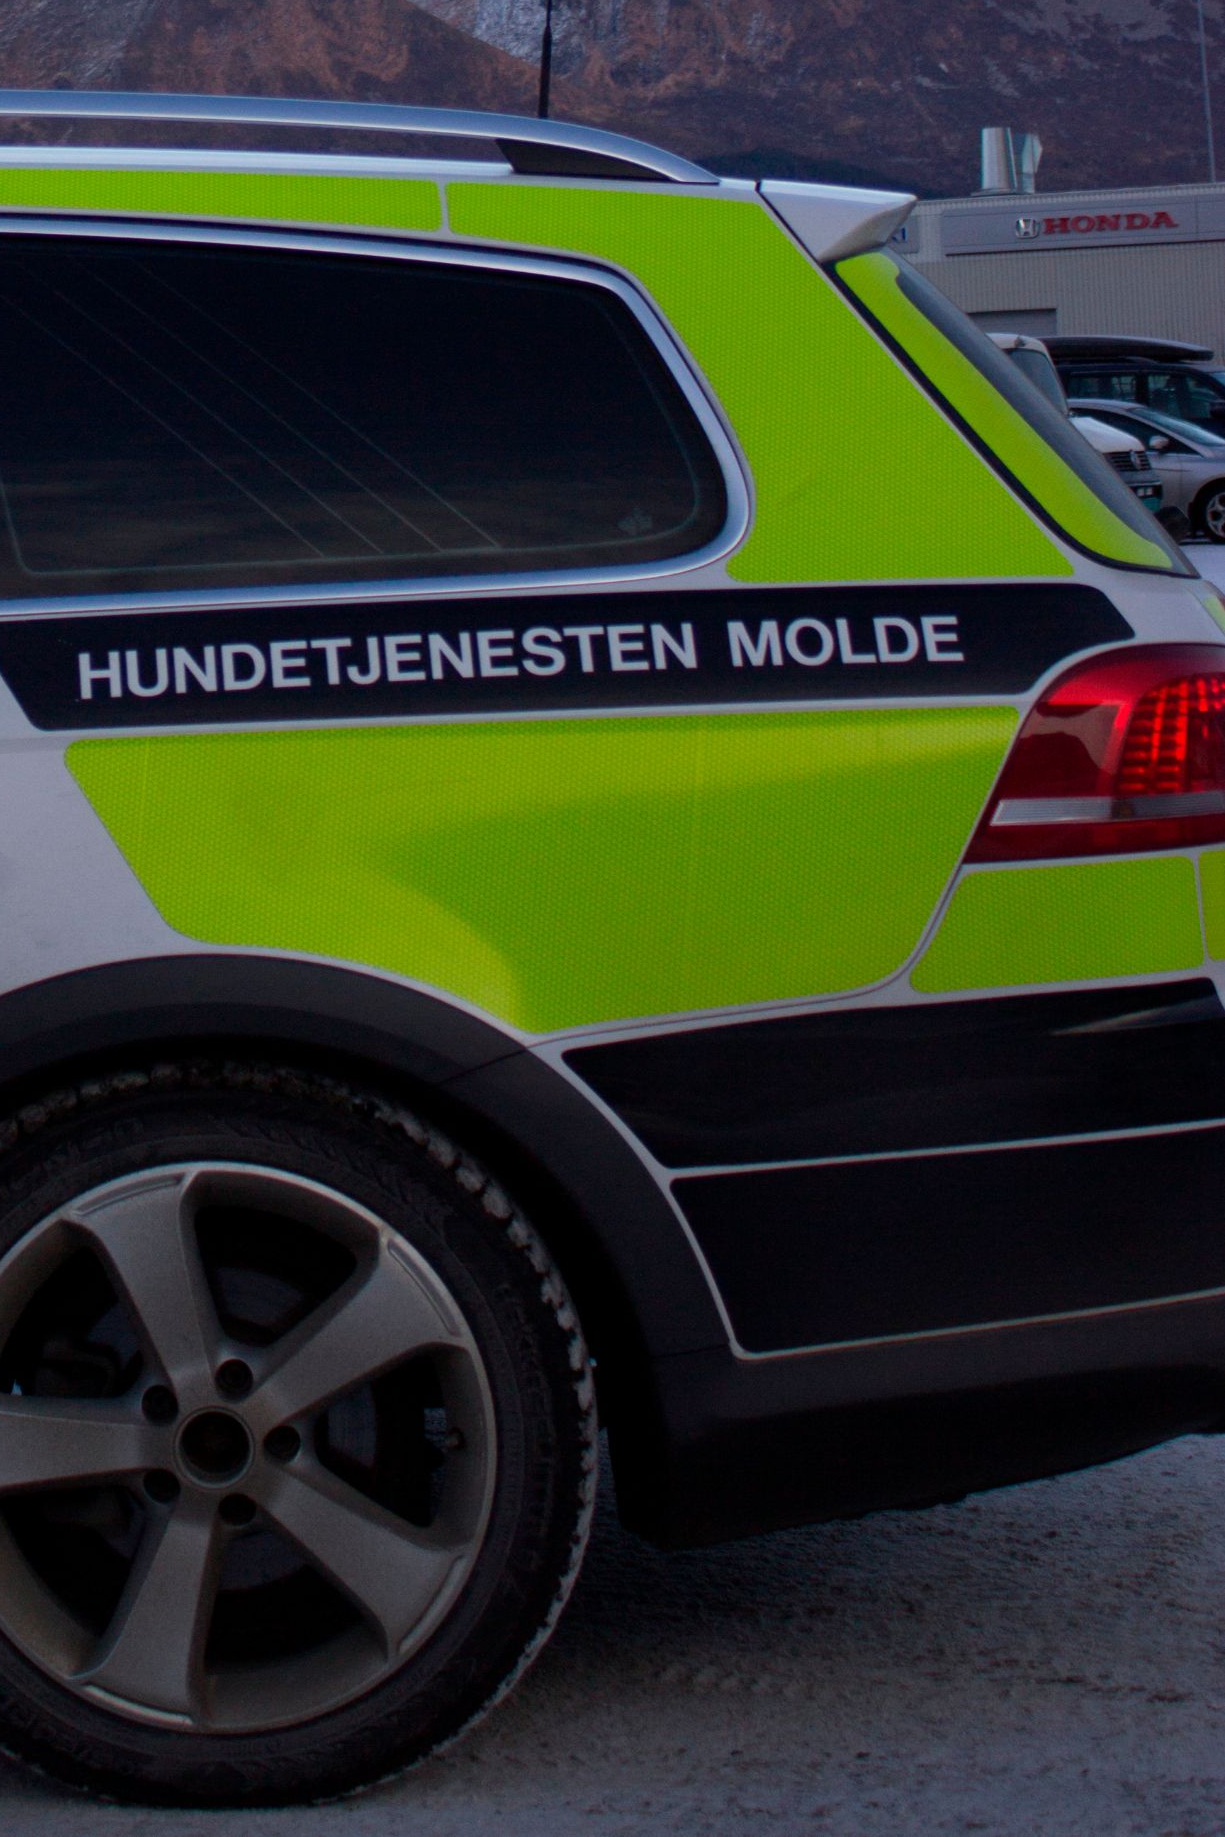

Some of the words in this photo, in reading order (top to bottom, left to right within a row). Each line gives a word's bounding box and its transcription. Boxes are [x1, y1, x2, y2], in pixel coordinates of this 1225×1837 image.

[1042, 211, 1178, 234] HONDA
[78, 622, 697, 700] HUNDETJENESTEN
[727, 615, 964, 667] MOLDE
